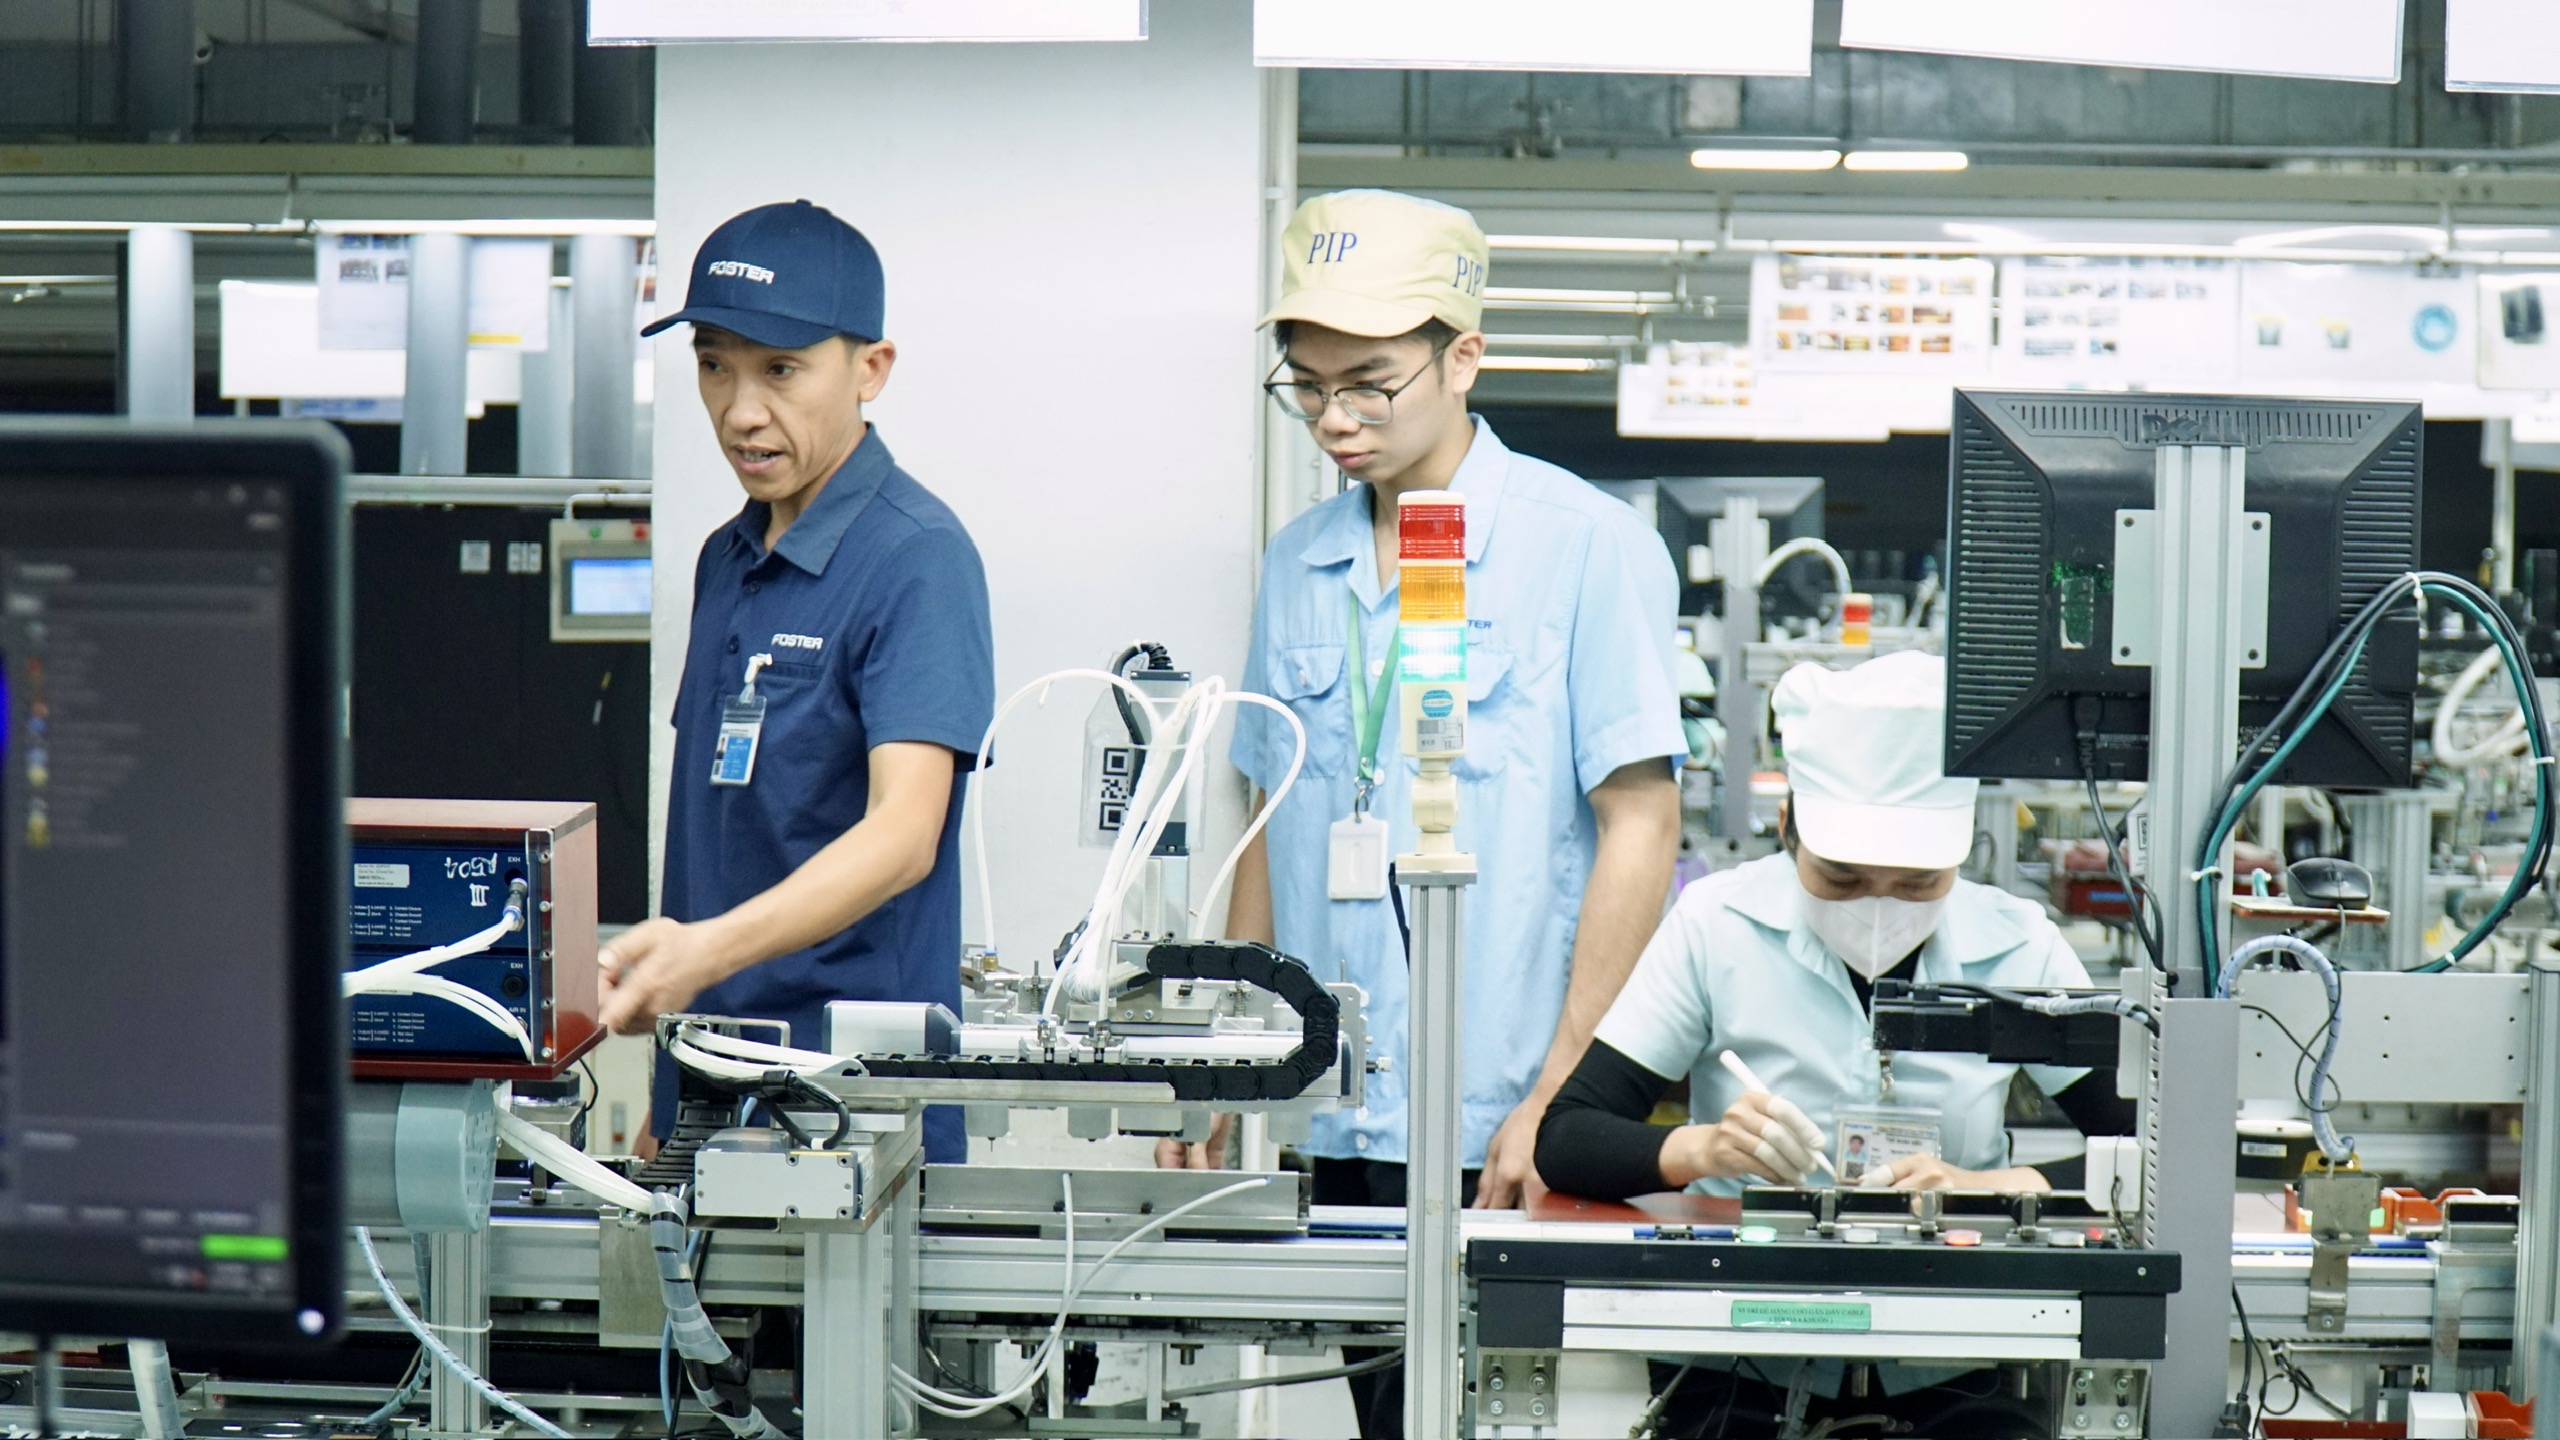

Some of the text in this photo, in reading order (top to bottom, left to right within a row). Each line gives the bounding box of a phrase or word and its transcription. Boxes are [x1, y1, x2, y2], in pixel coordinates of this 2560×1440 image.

[1307, 231, 1358, 265] PIP
[707, 260, 775, 285] FOSTER
[1451, 254, 1483, 298] PIP
[2141, 412, 2245, 442] DELL
[771, 633, 824, 650] FOSTER
[507, 855, 521, 863] EXH
